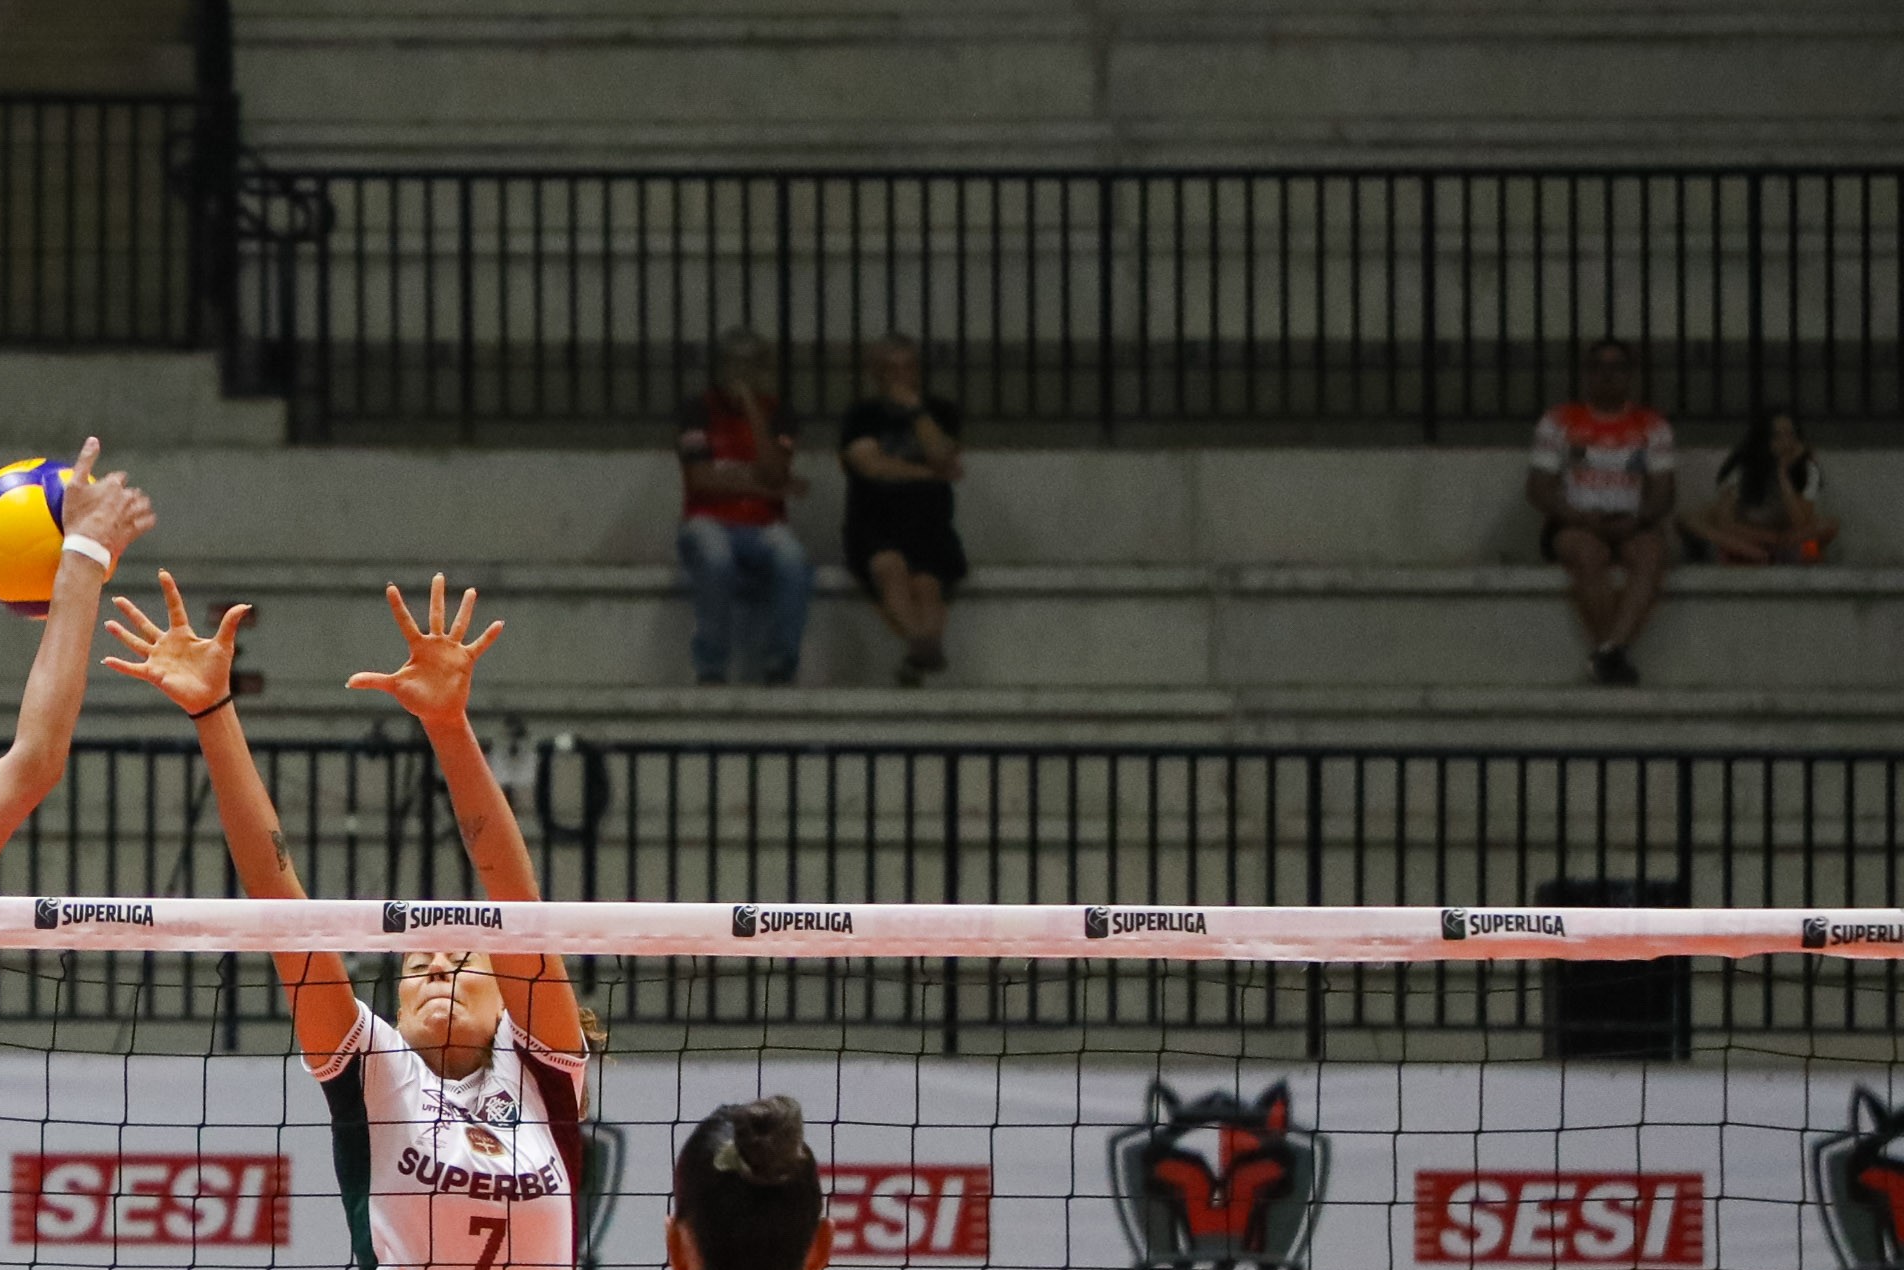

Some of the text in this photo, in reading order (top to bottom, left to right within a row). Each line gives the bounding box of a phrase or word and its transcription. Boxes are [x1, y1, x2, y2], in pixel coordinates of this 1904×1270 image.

[62, 904, 154, 926] SUPERLIGA
[410, 907, 502, 930] SUPERLIGA
[760, 911, 853, 934] SUPERLIGA
[1112, 912, 1206, 934] SUPERLIGA
[1470, 914, 1565, 937] SUPERLIGA
[1831, 924, 1904, 946] SUPERLI
[398, 1147, 563, 1202] SUPERBET
[36, 1163, 267, 1240] SESI
[820, 1174, 965, 1249] ESI
[1439, 1181, 1677, 1258] SESI
